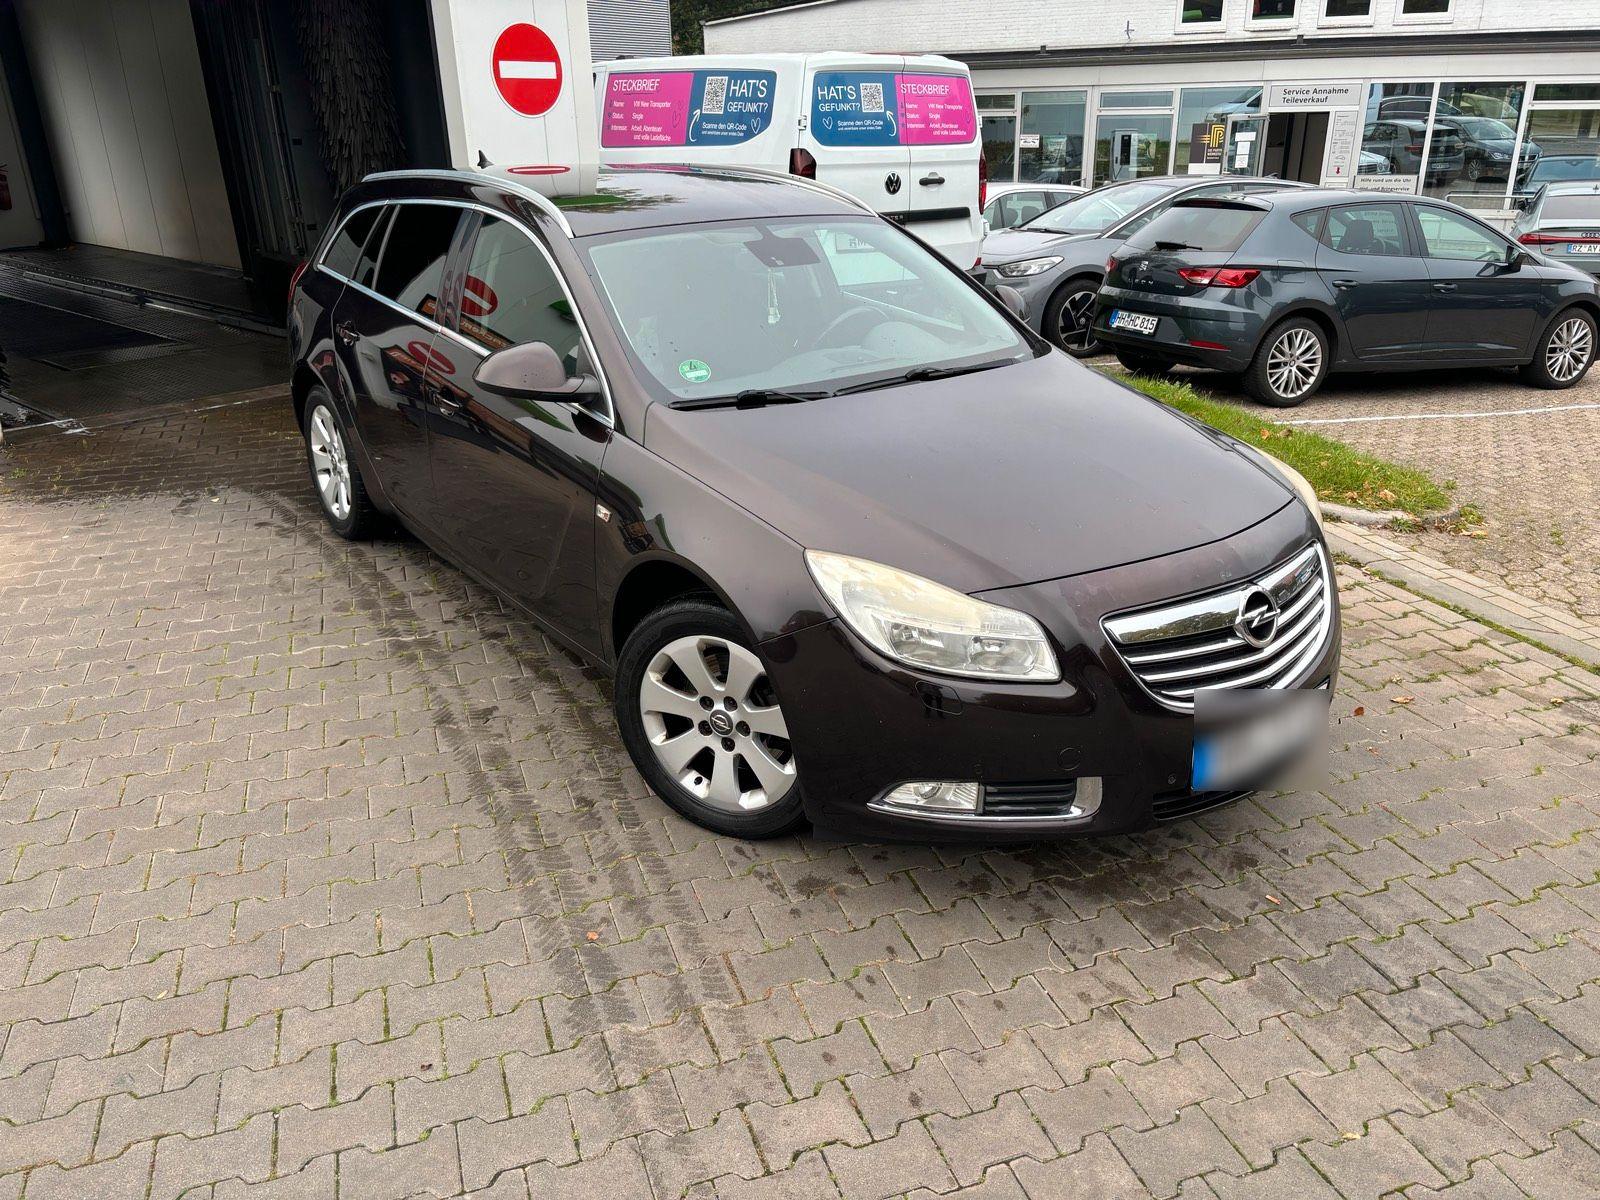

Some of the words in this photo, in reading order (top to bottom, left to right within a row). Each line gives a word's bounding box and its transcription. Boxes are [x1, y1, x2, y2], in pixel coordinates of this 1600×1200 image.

[612, 79, 660, 92] STECKBRIEF
[729, 79, 768, 98] HAT'S
[900, 83, 950, 95] STECKBRIEF
[817, 85, 857, 100] HAT'S
[1283, 88, 1310, 96] Service
[1312, 87, 1349, 95] Annahme
[650, 100, 672, 109] Transporter
[1282, 96, 1328, 104] Teileverkauf
[727, 101, 769, 113] GEFUNKT?
[818, 102, 861, 112] GEFUNKT?
[944, 103, 963, 111] Transporter
[632, 112, 644, 121] Single
[928, 112, 940, 120] Single
[702, 121, 718, 129] Scanne
[726, 122, 747, 131] QR-Code
[1572, 244, 1583, 253] RZ
[1587, 244, 1598, 253] AY
[1116, 312, 1127, 326] HH
[1129, 314, 1140, 328] HC
[1140, 316, 1157, 331] 815
